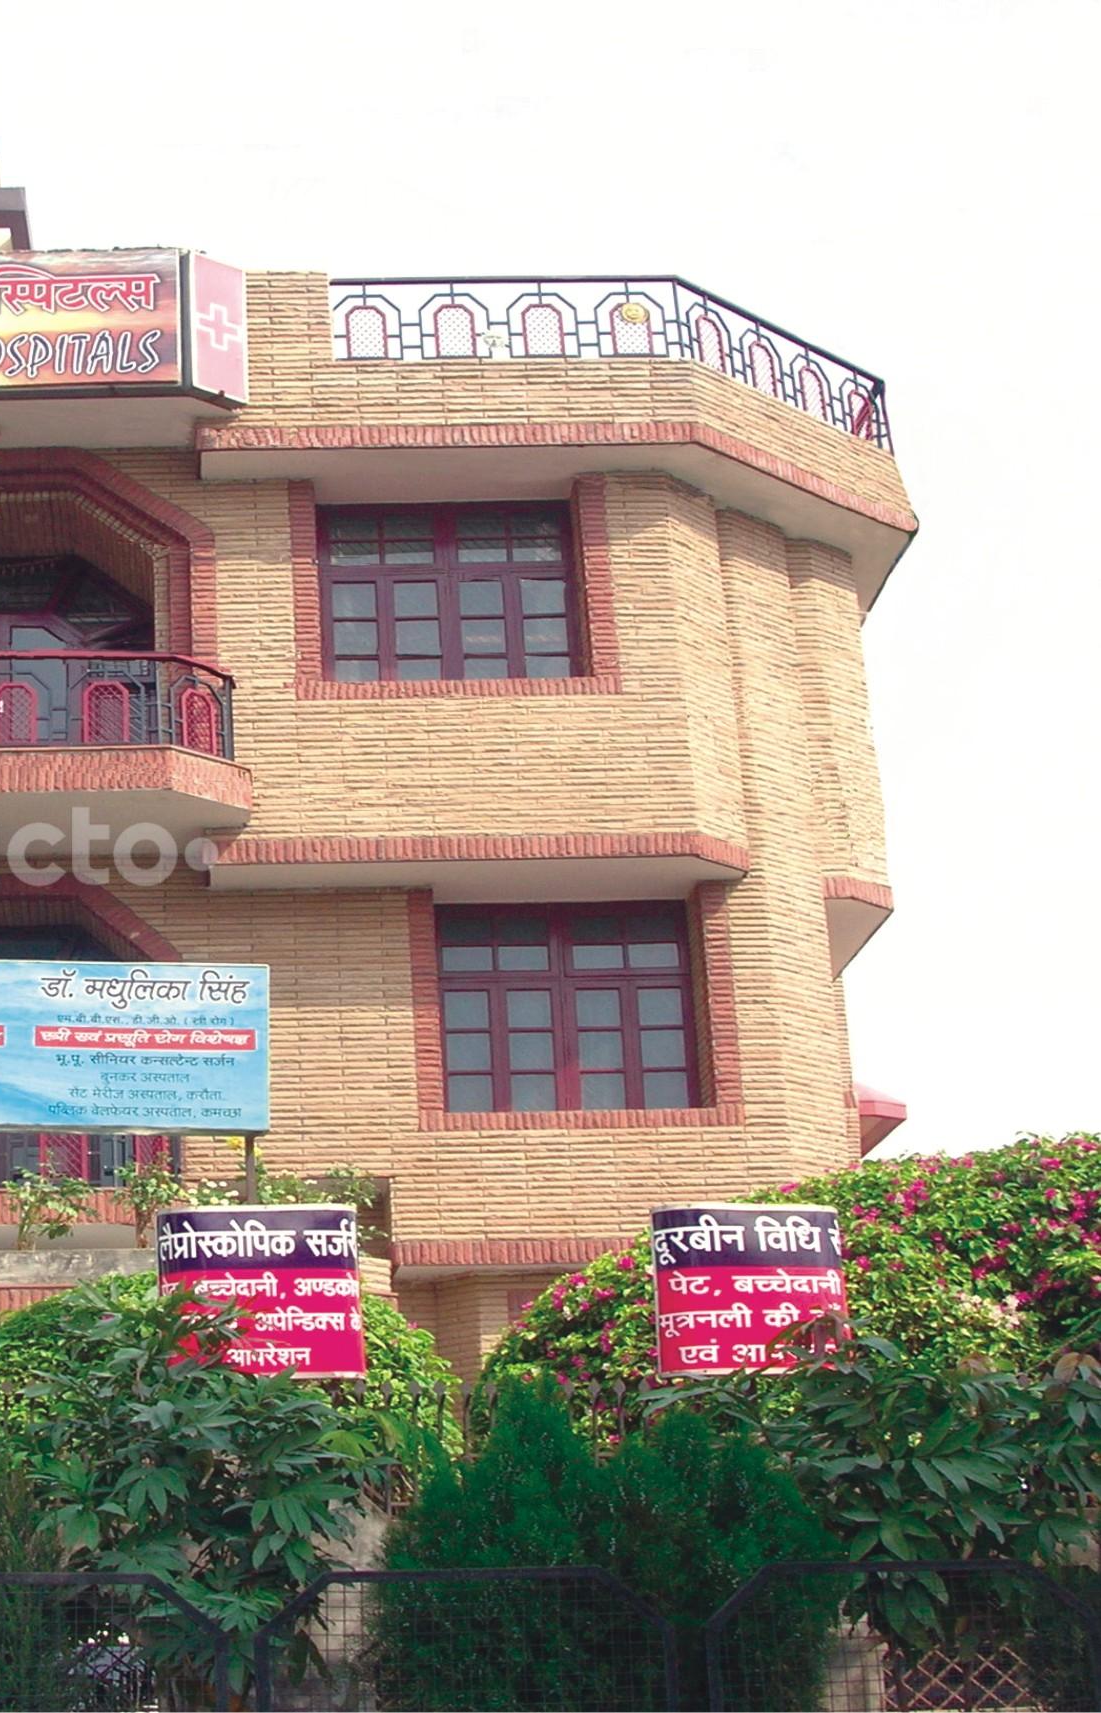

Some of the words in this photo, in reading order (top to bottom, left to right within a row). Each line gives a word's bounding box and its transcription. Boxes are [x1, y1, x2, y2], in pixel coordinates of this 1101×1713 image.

[41, 970, 76, 998] डॉ.
[84, 969, 191, 1009] मधुलिका
[199, 970, 250, 1004] सिंह
[89, 1052, 137, 1065] सीनियर
[202, 1053, 235, 1067] सर्जन
[140, 1072, 190, 1083] अस्पताल
[48, 1101, 88, 1115] पब्लिक
[158, 1219, 296, 1261] लैप्रोस्कोपिक
[654, 1214, 745, 1265] दूरबीन
[754, 1216, 821, 1252] विधि
[669, 1271, 722, 1297] पेट,
[732, 1268, 842, 1295] बच्चेदानी
[659, 1302, 752, 1337] मूत्रनली
[763, 1302, 801, 1327] की
[679, 1339, 720, 1364] एवं
